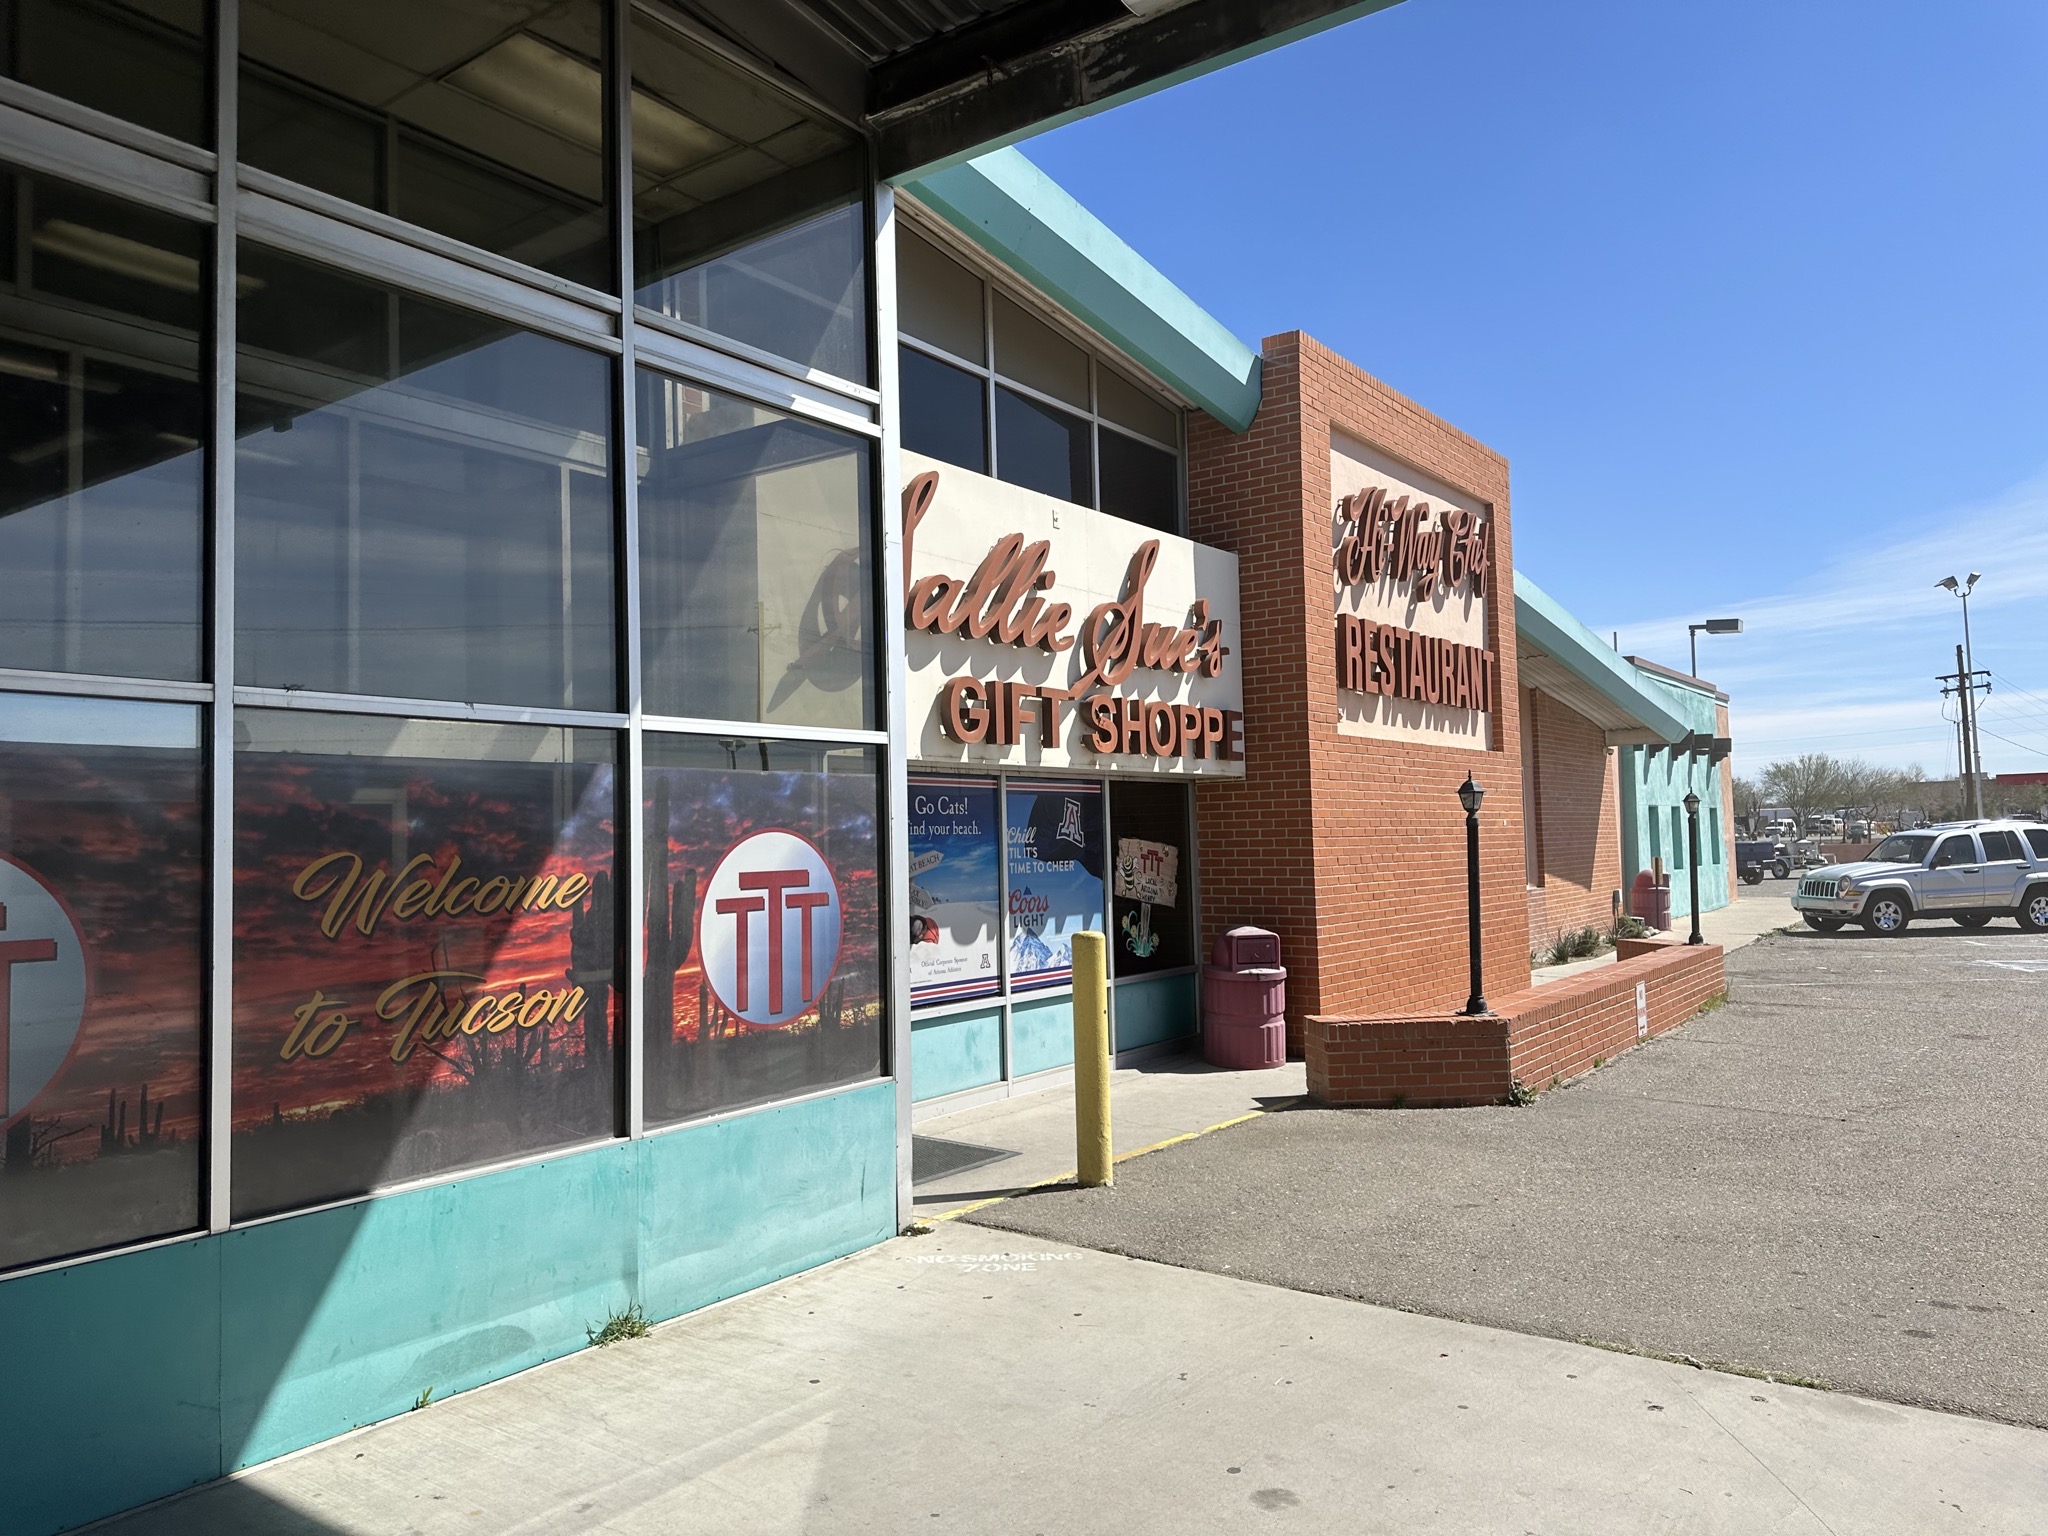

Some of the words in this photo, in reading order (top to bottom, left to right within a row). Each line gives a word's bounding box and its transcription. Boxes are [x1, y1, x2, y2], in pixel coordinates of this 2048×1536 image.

[1440, 508, 1490, 598] Chef
[1069, 539, 1230, 700] Sue's
[1337, 613, 1495, 713] RESTAURANT
[942, 676, 1072, 749] GIFT
[1080, 693, 1244, 761] SHOPPE
[915, 795, 935, 815] Go
[938, 795, 968, 815] Cats!
[908, 820, 926, 835] ind
[928, 825, 950, 841] your
[952, 820, 982, 835] beach.
[1008, 826, 1037, 844] Chill
[918, 853, 940, 869] BEACH
[1023, 846, 1038, 859] IT'S
[1141, 849, 1164, 877] TTT
[1009, 862, 1031, 875] TIME
[1033, 861, 1045, 873] TO
[1046, 860, 1075, 872] CHEER
[293, 851, 593, 940] Welcome
[1009, 888, 1049, 915] Coors
[1013, 913, 1045, 929] LIGHT
[715, 869, 830, 1016] TTT
[279, 990, 361, 1063] to
[373, 970, 590, 1064] Tucson
[916, 1254, 955, 1264] NO
[959, 1252, 1084, 1263] SMOKING
[961, 1262, 1037, 1273] ZONE
